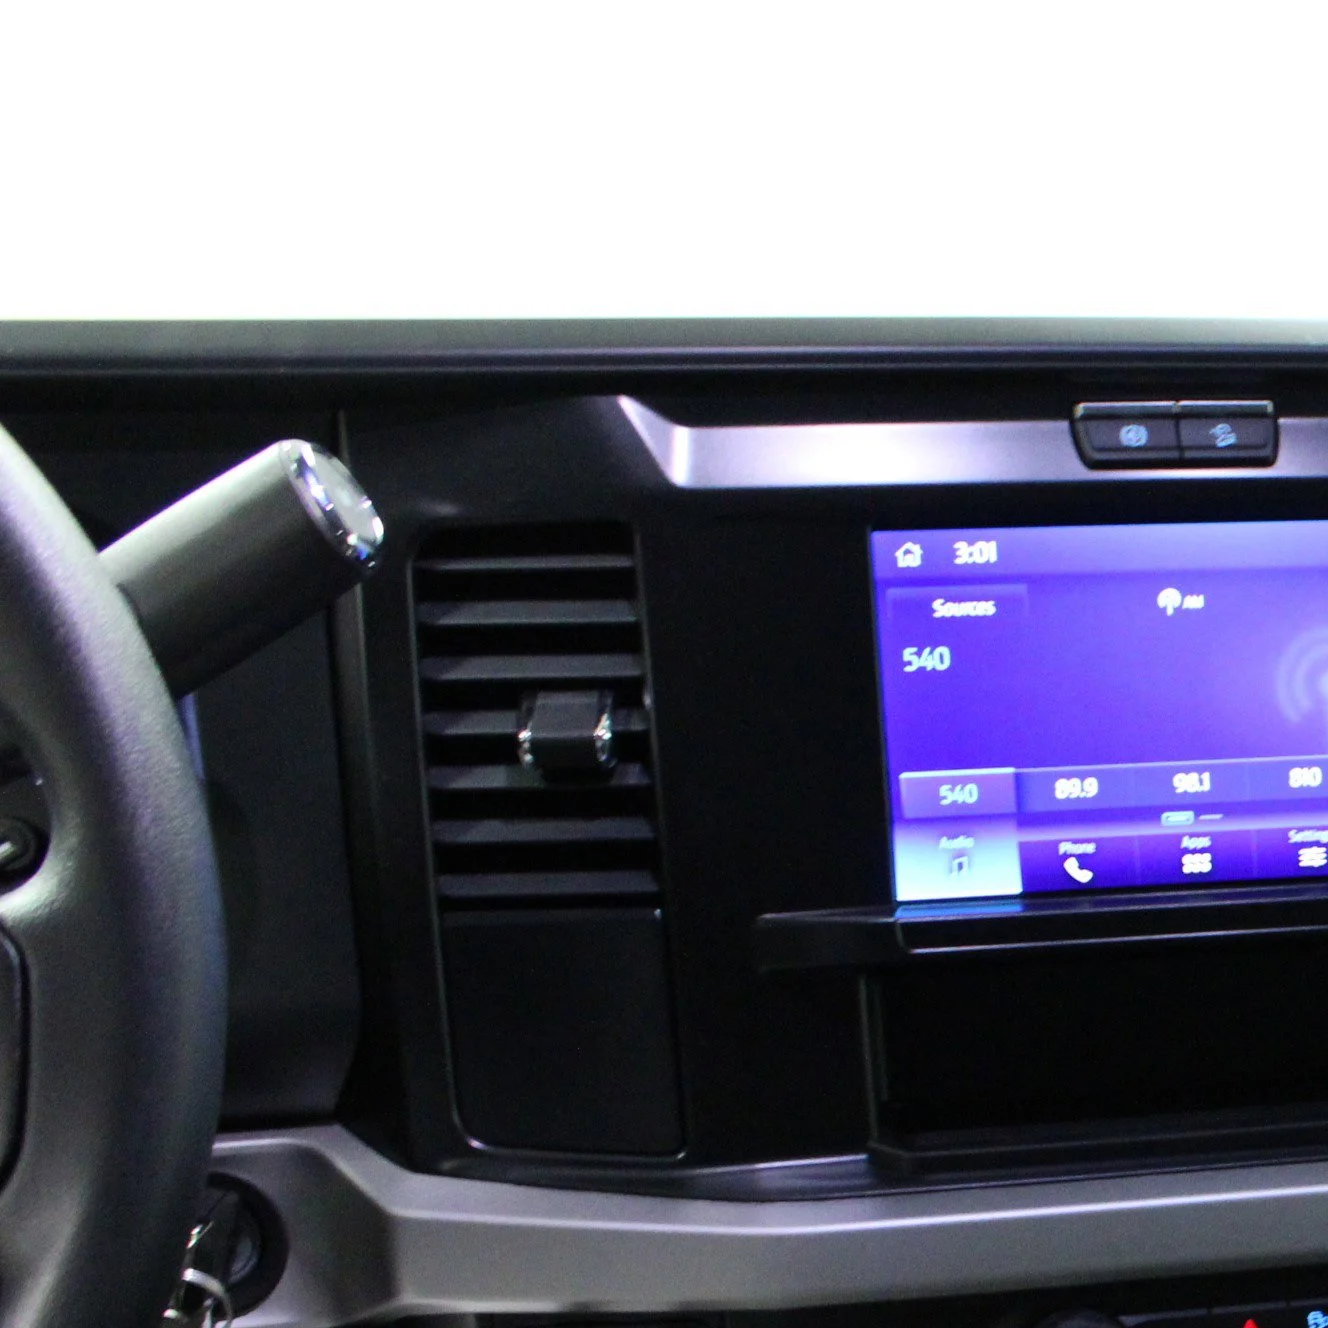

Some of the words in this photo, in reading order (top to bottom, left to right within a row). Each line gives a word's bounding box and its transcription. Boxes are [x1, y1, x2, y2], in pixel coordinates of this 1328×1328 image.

[953, 541, 998, 564] 3:01
[932, 599, 997, 618] Sources
[1182, 594, 1205, 609] AM
[902, 646, 951, 672] 540
[939, 783, 979, 806] 540
[1055, 777, 1099, 800] 89.9
[1172, 772, 1211, 793] 98.1
[1288, 766, 1323, 788] 810
[1058, 841, 1097, 856] Phone
[1180, 835, 1212, 850] Apps
